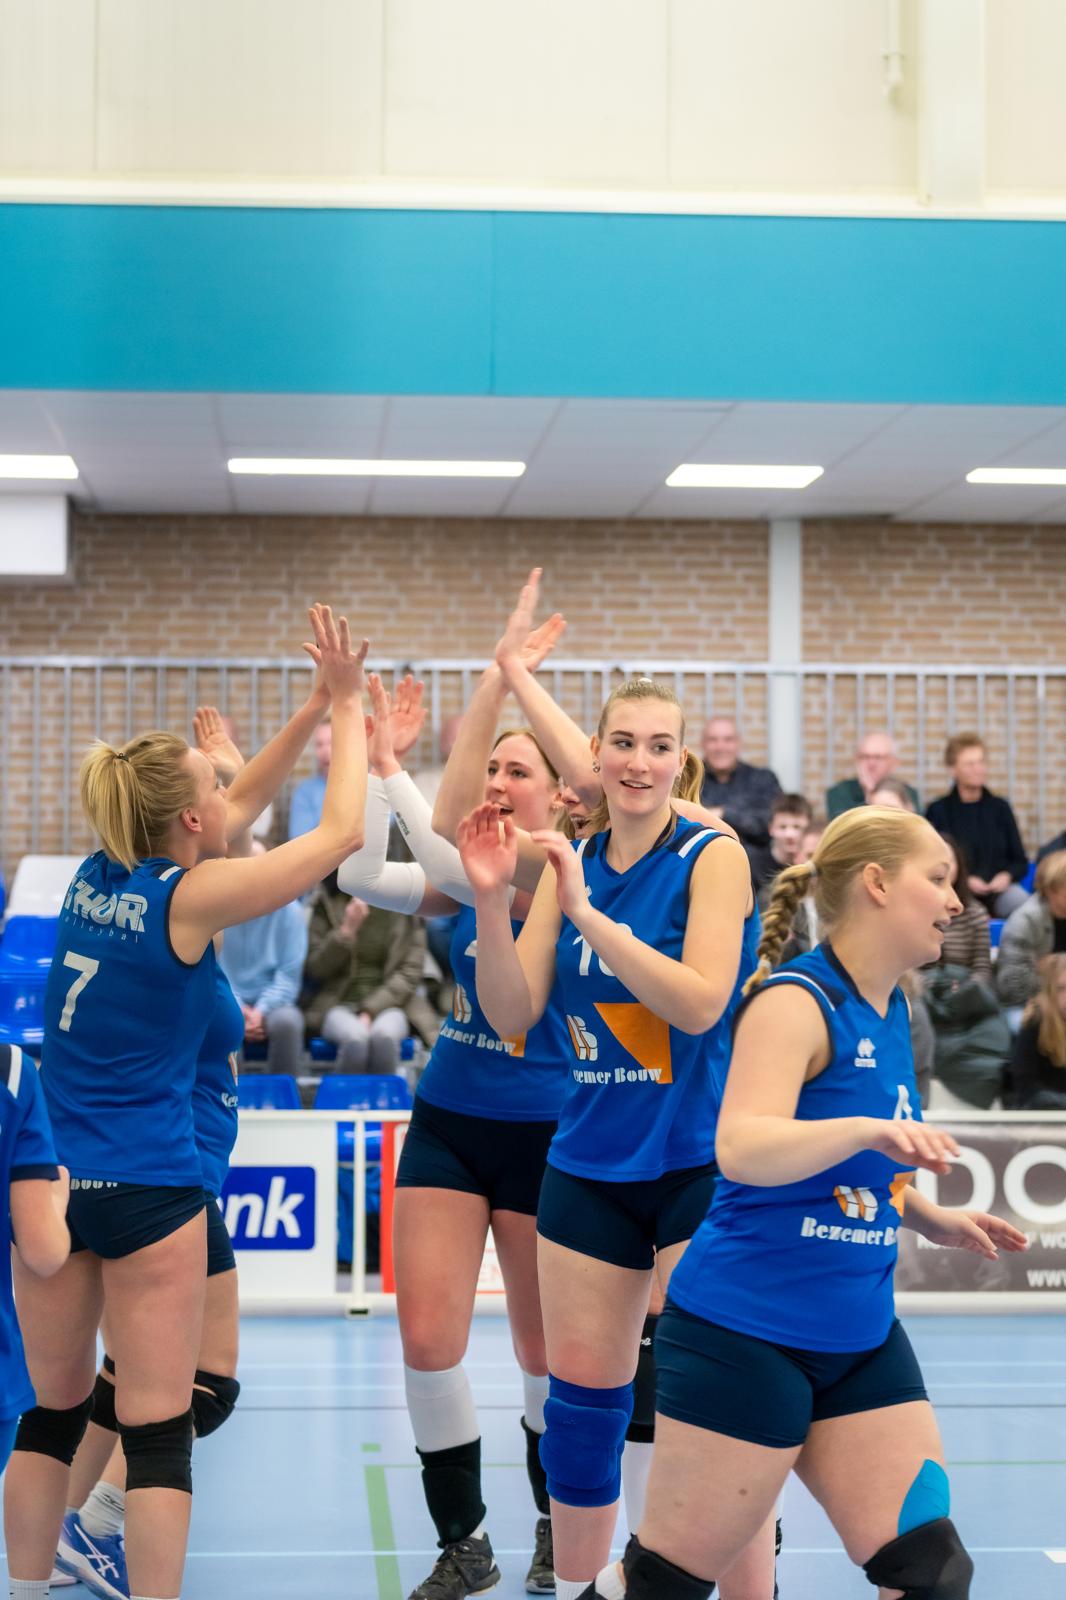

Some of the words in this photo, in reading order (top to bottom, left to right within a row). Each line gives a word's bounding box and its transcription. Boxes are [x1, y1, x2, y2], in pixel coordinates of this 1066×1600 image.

[59, 951, 99, 1032] 7
[614, 1067, 663, 1084] Bouw
[218, 1176, 305, 1239] nk
[801, 1216, 884, 1246] Bezemer
[883, 1226, 897, 1247] B
